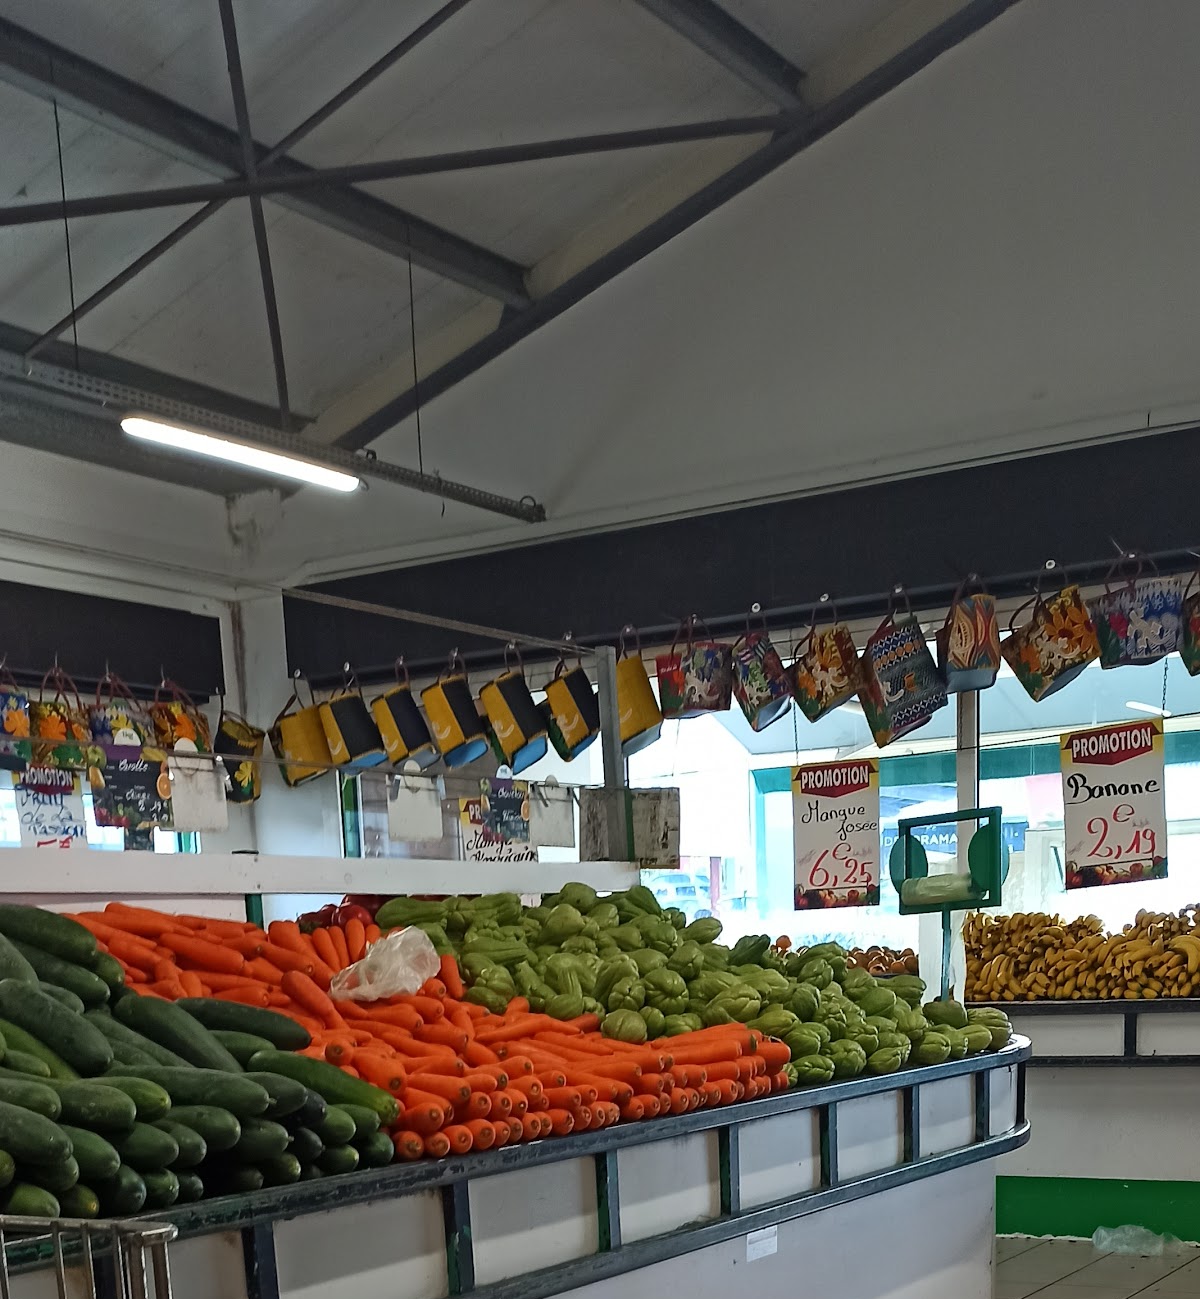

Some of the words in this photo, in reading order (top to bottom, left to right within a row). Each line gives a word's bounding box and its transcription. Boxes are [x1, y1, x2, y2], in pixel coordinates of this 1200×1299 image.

[1072, 727, 1151, 758] PROMOTION
[801, 765, 869, 789] PROMOTION
[1065, 773, 1160, 805] Banane
[801, 799, 865, 824] Mangue
[884, 833, 959, 847] DRAMA
[1086, 817, 1157, 860] 2,19
[809, 849, 874, 888] 6,25
